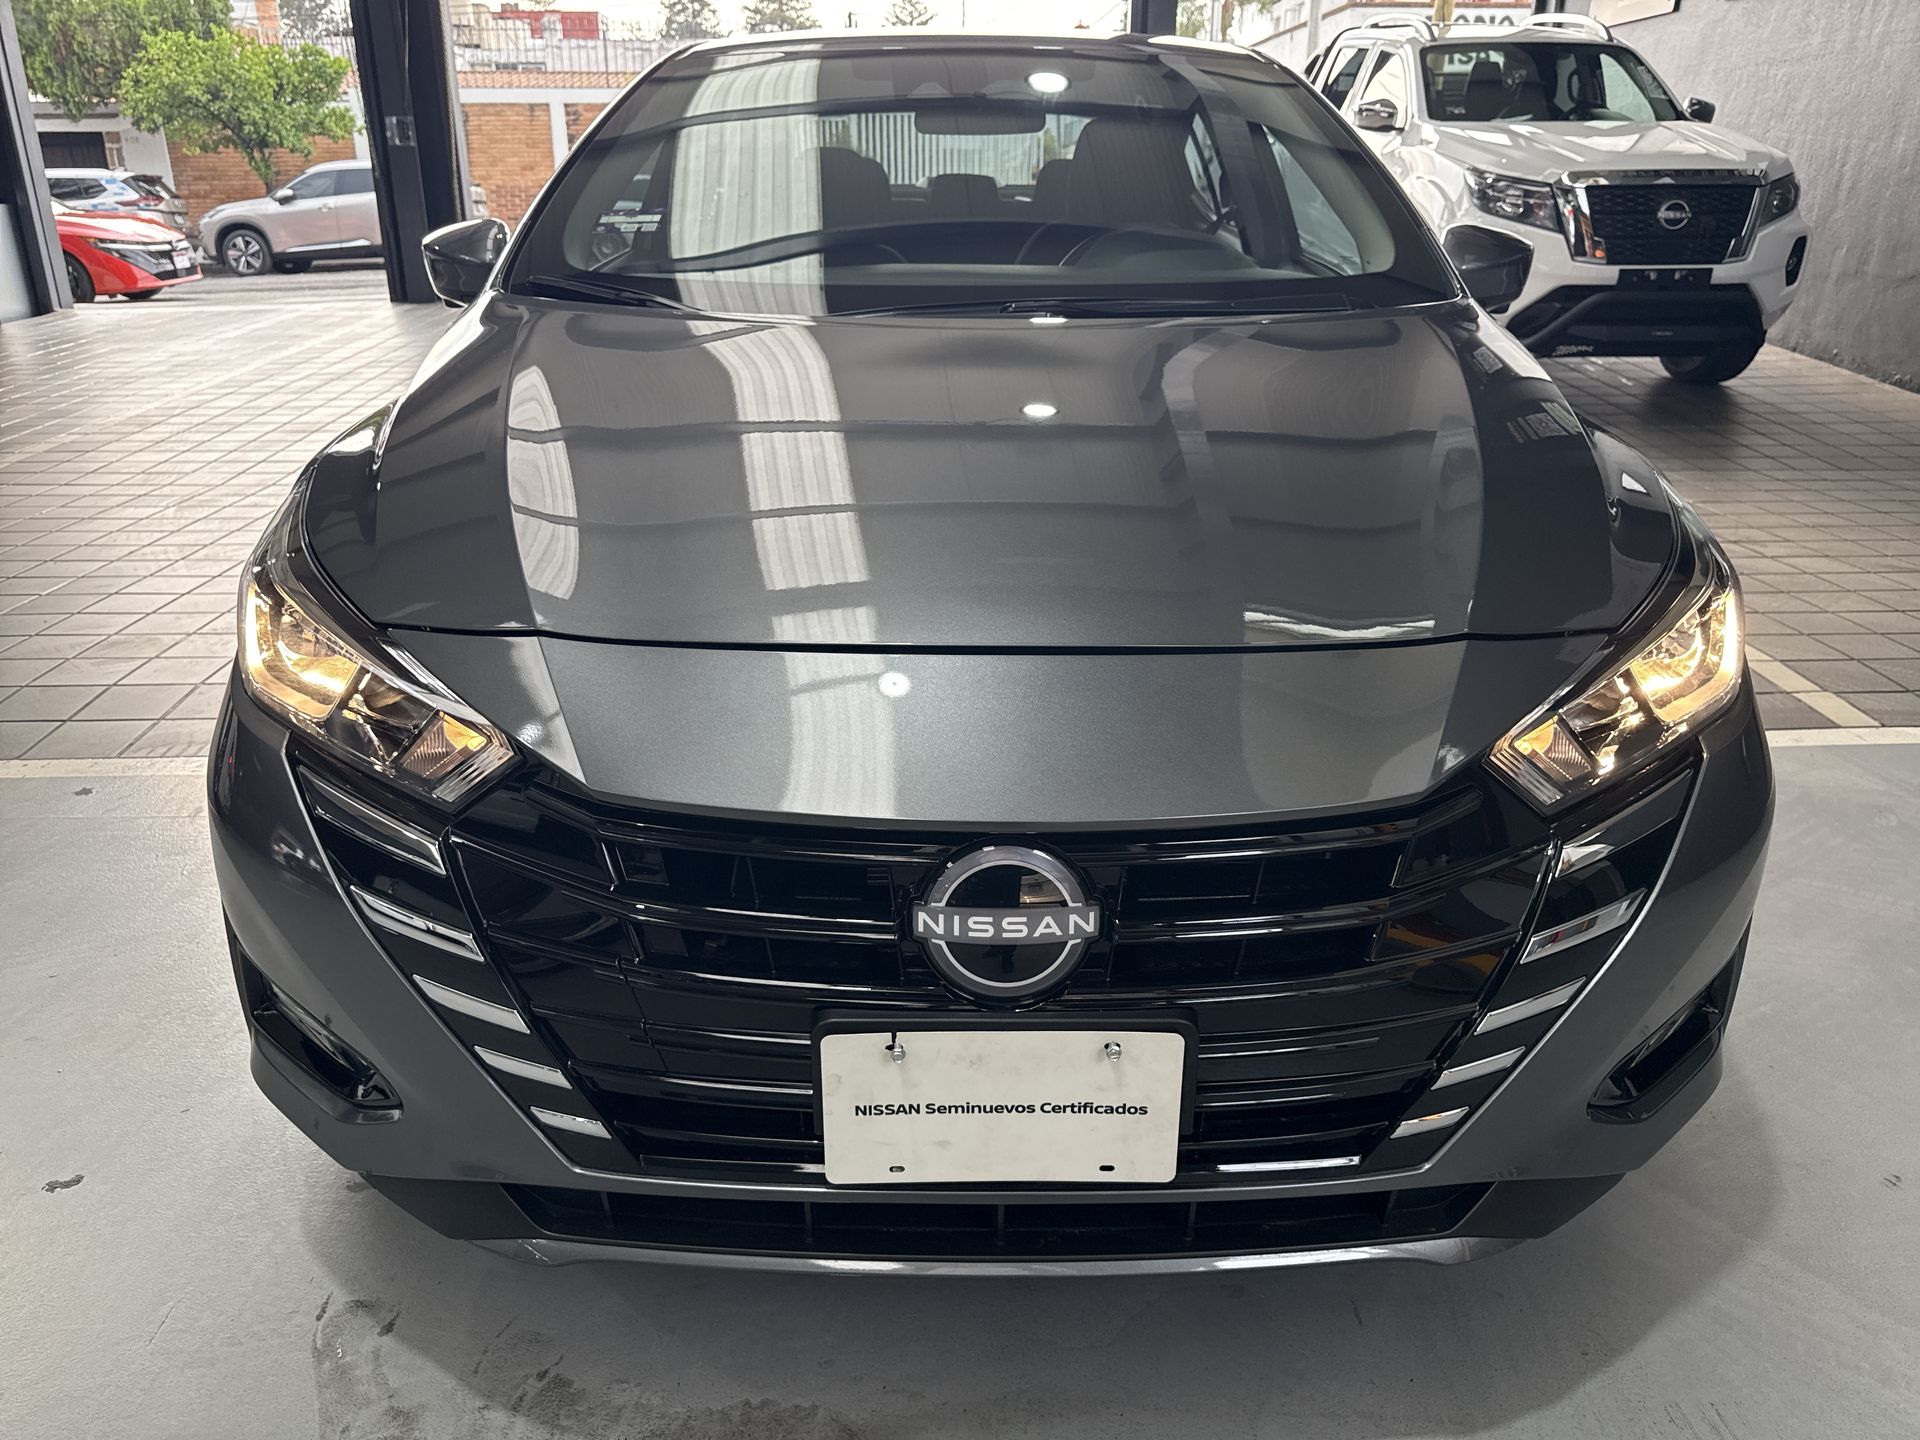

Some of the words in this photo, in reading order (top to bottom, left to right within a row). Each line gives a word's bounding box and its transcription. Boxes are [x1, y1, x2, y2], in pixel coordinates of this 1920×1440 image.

[917, 911, 1095, 938] NISSAN
[855, 1103, 921, 1116] NISSAN
[925, 1102, 1036, 1115] Seminuevos
[1040, 1102, 1148, 1115] Certificados
